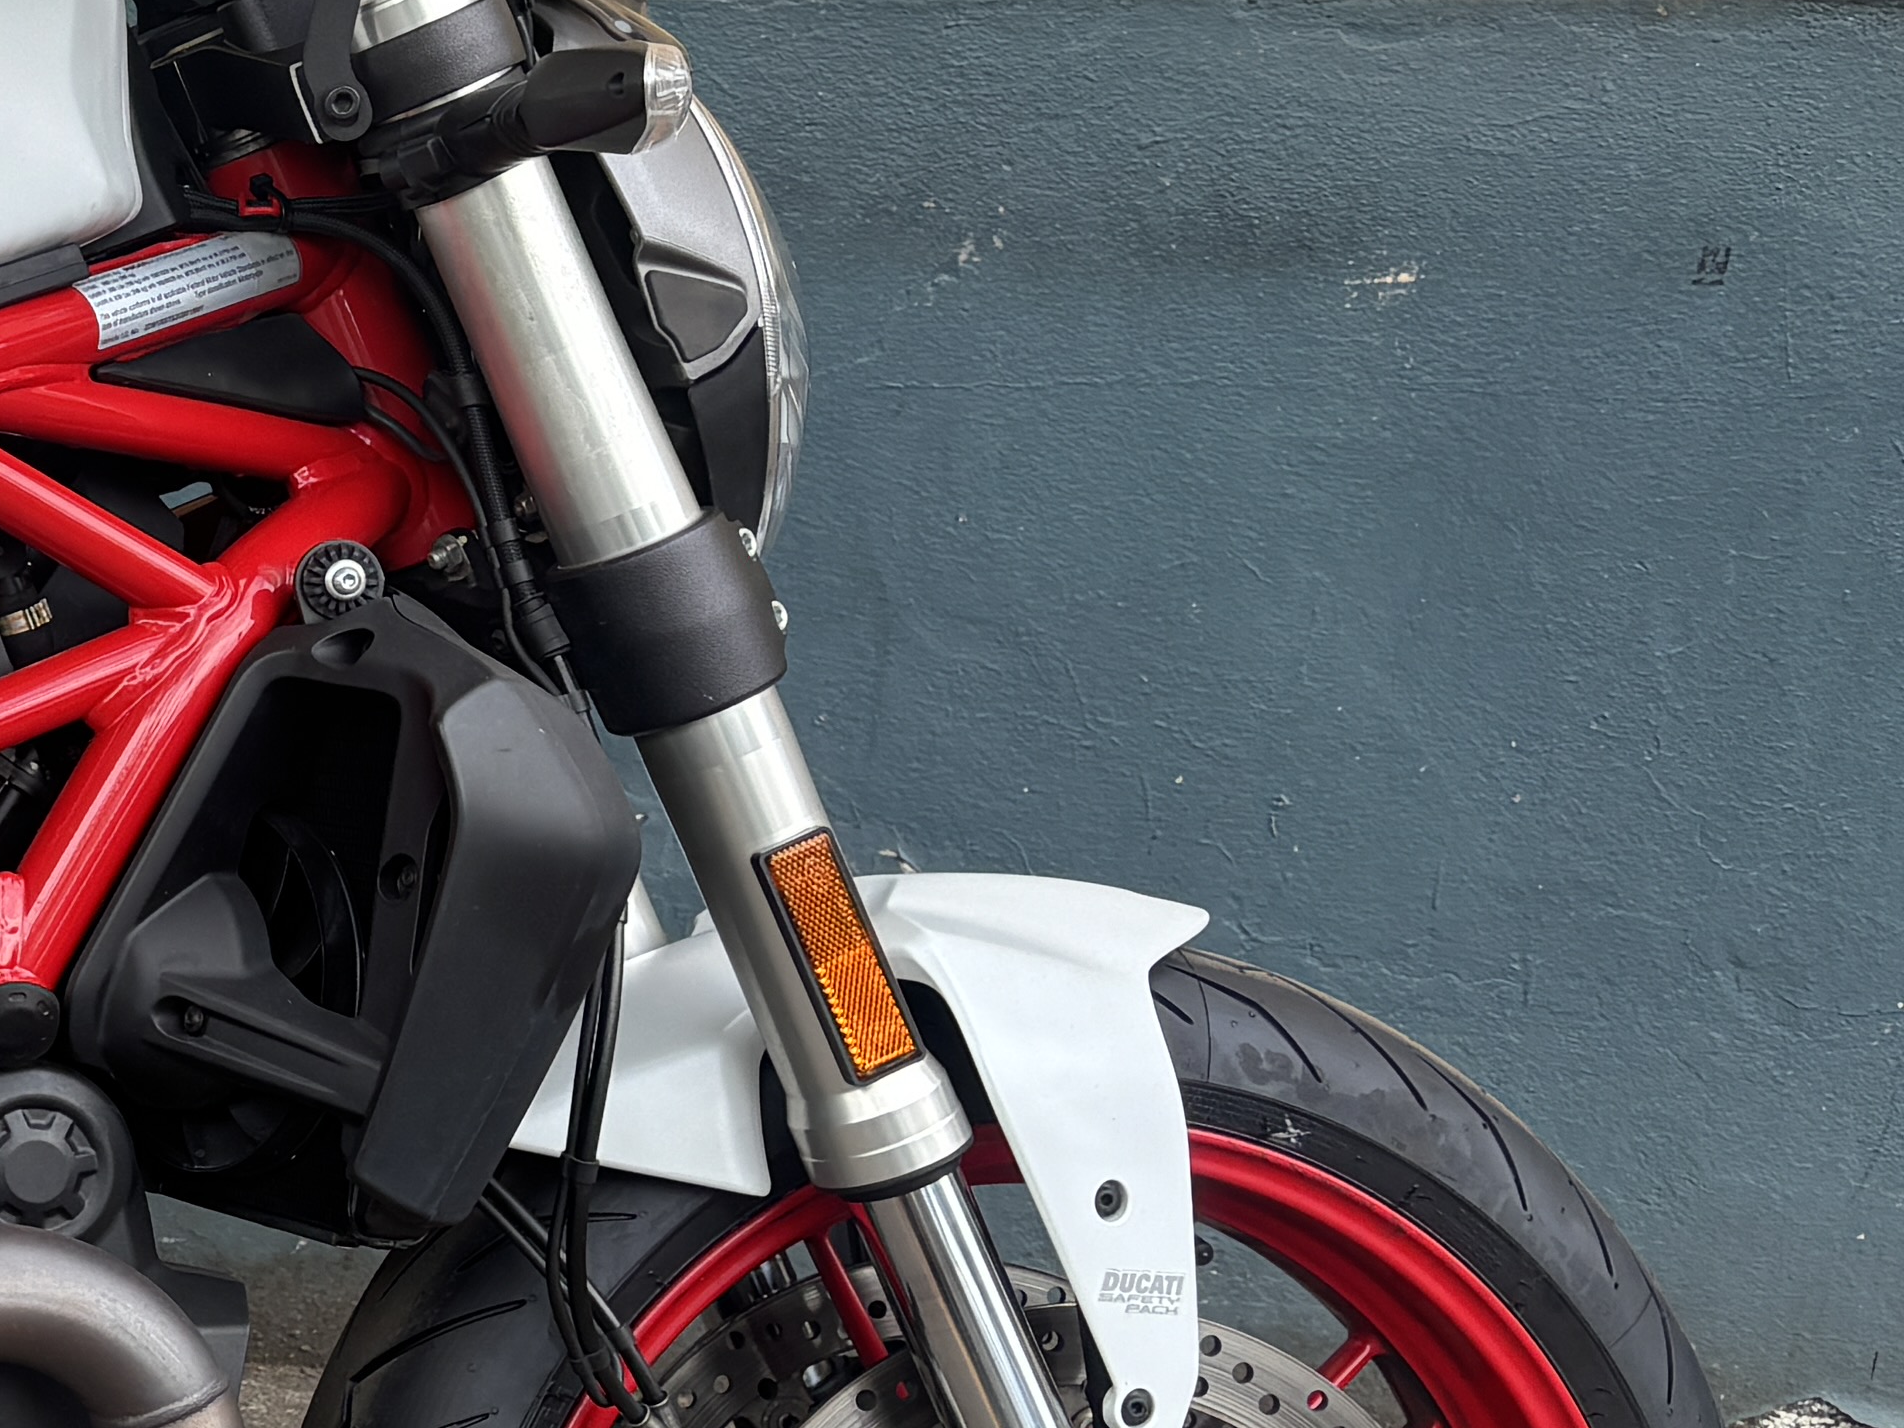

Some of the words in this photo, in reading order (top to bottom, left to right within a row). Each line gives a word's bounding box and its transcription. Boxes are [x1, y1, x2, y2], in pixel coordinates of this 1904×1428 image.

[1101, 1271, 1184, 1296] DUCATI
[1097, 1292, 1181, 1303] SAFETY
[1124, 1304, 1179, 1316] PACK
